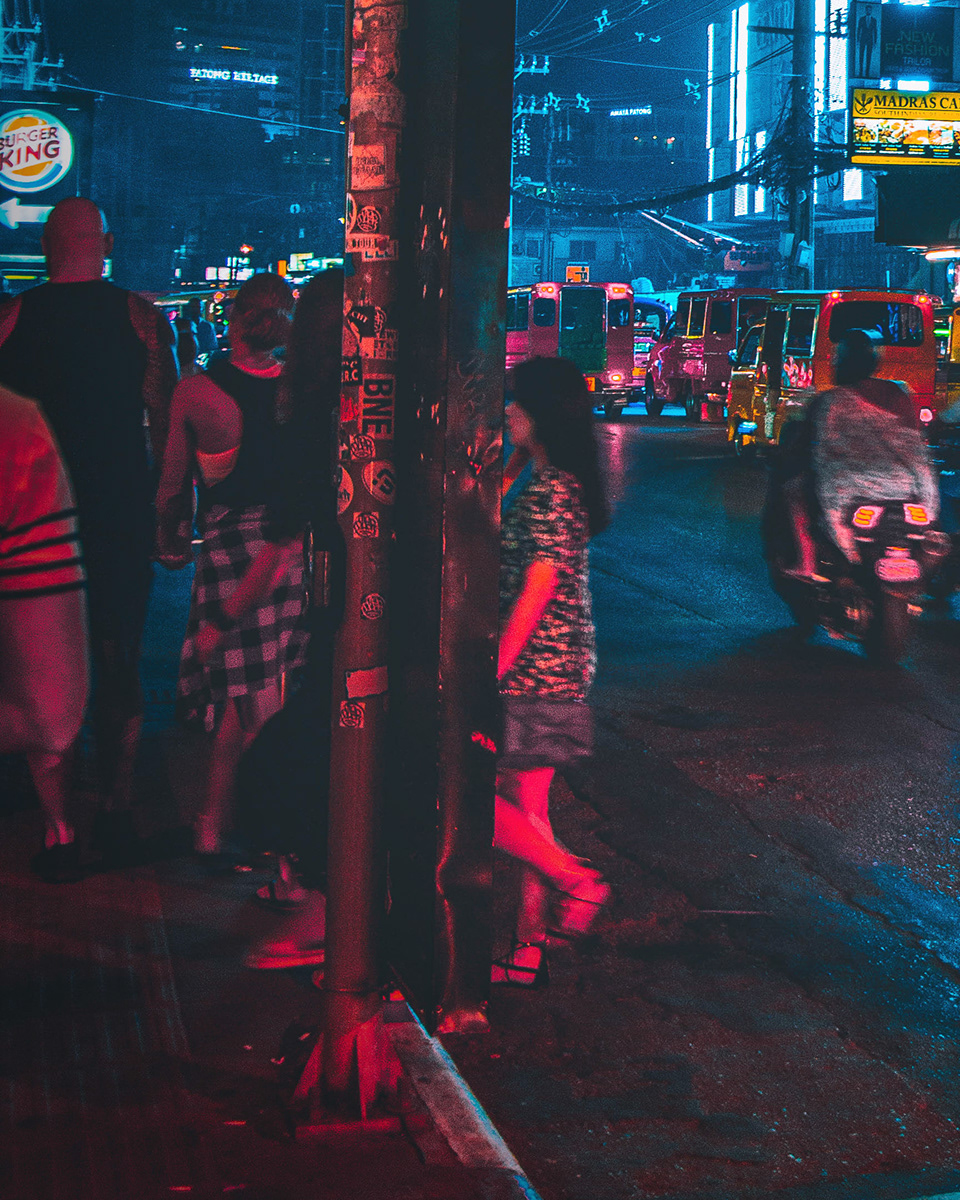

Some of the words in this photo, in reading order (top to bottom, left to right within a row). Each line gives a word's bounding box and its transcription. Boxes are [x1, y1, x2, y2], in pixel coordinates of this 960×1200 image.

[898, 31, 934, 43] NEW
[885, 42, 949, 57] FASHION
[902, 57, 932, 67] TAILOR
[873, 95, 936, 108] MADRAS
[0, 140, 60, 171] KING
[362, 379, 394, 434] BNE
